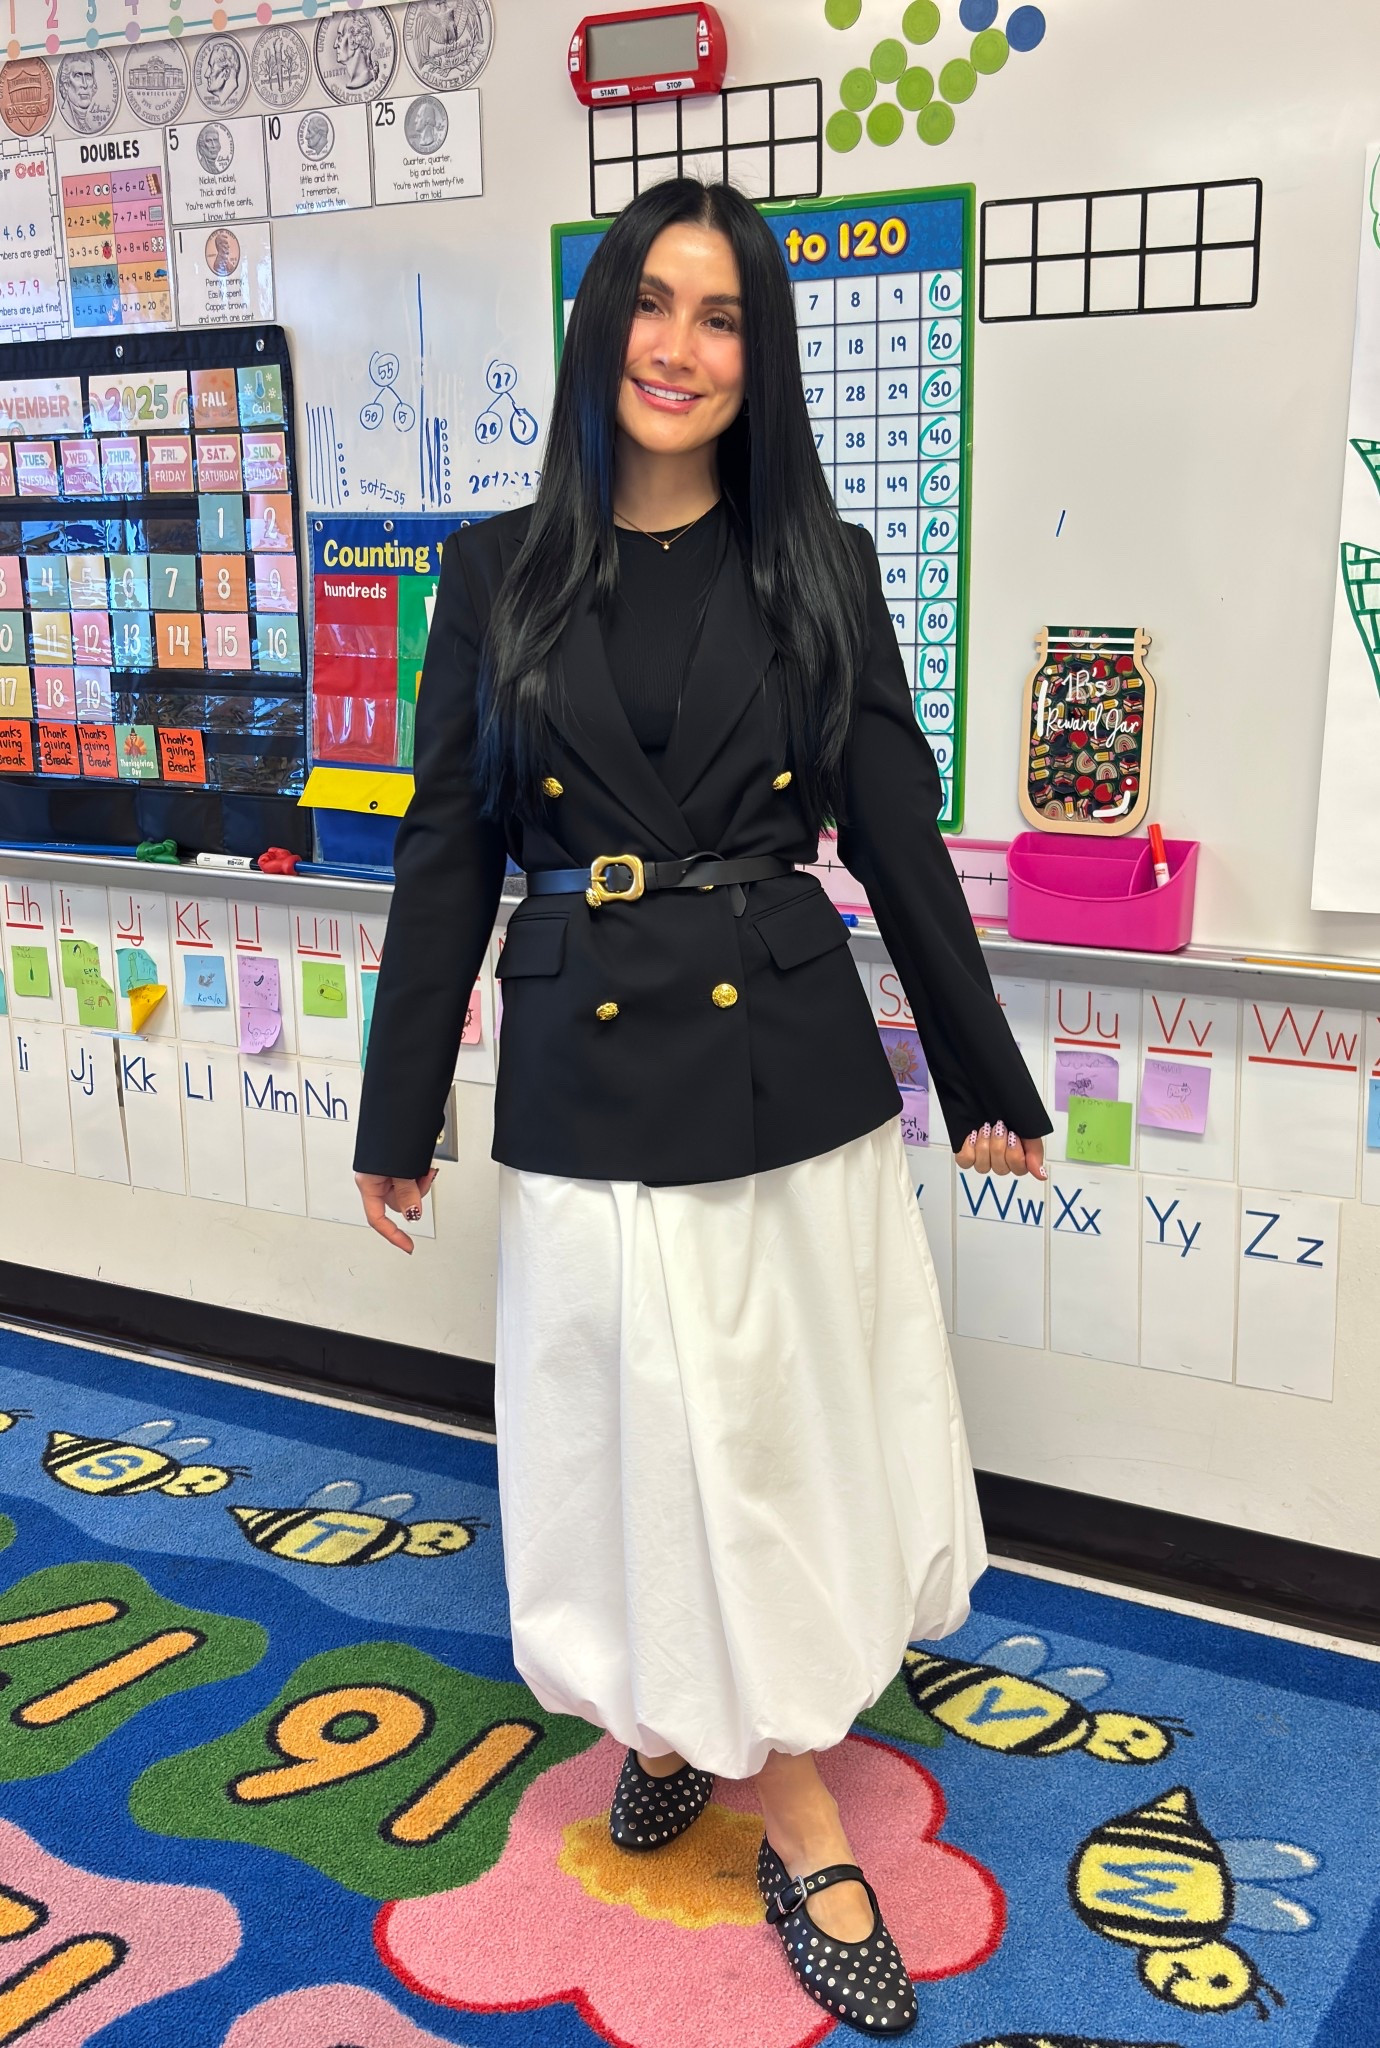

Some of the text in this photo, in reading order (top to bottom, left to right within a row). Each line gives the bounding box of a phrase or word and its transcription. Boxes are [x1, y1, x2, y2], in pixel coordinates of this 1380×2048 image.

[600, 88, 618, 97] START
[666, 81, 682, 90] STOP
[375, 102, 395, 127] 25
[268, 116, 281, 140] 10
[169, 128, 179, 151] 5
[80, 140, 140, 163] DOUBLES
[15, 161, 45, 179] Odd
[785, 216, 908, 265] to 120
[20, 250, 31, 258] are
[809, 294, 819, 310] 7
[850, 291, 861, 307] 8
[893, 288, 904, 304] 9
[934, 285, 951, 302] 10
[807, 341, 822, 358] 17
[848, 338, 864, 355] 18
[891, 336, 907, 352] 19
[931, 333, 952, 350] 20
[377, 362, 394, 380] 55
[804, 388, 824, 404] 27
[845, 385, 866, 402] 28
[888, 383, 908, 400] 29
[930, 381, 952, 398] 30
[104, 384, 169, 421] 2025
[202, 390, 228, 408] FALL
[252, 402, 271, 415] Cold
[364, 411, 378, 422] 50
[845, 432, 866, 449] 38
[887, 430, 908, 447] 39
[929, 428, 952, 445] 40
[23, 455, 48, 466] TUES.
[69, 452, 88, 464] WED.
[108, 450, 133, 463] THUR.
[161, 449, 178, 461] FRI.
[207, 448, 229, 460] SAT.
[253, 446, 274, 458] SUN.
[155, 470, 187, 482] FRIDAY
[200, 470, 239, 482] SATURDAY
[249, 467, 283, 480] SUNDAY
[844, 478, 866, 494] 48
[886, 476, 908, 493] 49
[928, 475, 951, 492] 50
[217, 507, 224, 539] 1
[263, 507, 278, 539] 2
[886, 522, 908, 538] 59
[928, 520, 950, 537] 60
[323, 538, 431, 574] Counting
[42, 567, 54, 596] 4
[82, 567, 94, 597] 5
[165, 567, 178, 598] 7
[218, 568, 231, 600] 8
[269, 568, 282, 600] 9
[886, 568, 906, 584] 69
[928, 568, 949, 584] 70
[324, 580, 387, 600] hundreds
[928, 613, 948, 629] 80
[45, 624, 58, 653] 11
[83, 624, 100, 654] 12
[124, 624, 142, 655] 13
[167, 625, 190, 656] 14
[216, 626, 238, 657] 15
[267, 627, 288, 659] 16
[927, 658, 947, 674] 90
[46, 678, 65, 708] 18
[86, 680, 101, 709] 19
[924, 703, 950, 718] 100
[1046, 701, 1139, 748] Reward Jar
[79, 727, 108, 740] Thanks
[160, 732, 194, 746] Thanks
[44, 741, 72, 754] giving
[84, 741, 110, 756] giving
[166, 746, 196, 760] giving
[45, 753, 73, 766] Break
[87, 754, 112, 768] Break
[120, 759, 154, 770] Thanksgiving
[168, 760, 197, 773] Break
[132, 768, 142, 777] Day
[5, 884, 42, 923] Hh
[117, 896, 143, 947] Jj
[176, 900, 212, 941] Kk
[198, 992, 223, 1005] Koala
[1058, 988, 1119, 1040] Uu
[1152, 995, 1213, 1048] Vv
[1252, 1003, 1358, 1061] Ww
[70, 1047, 94, 1096] Jj
[123, 1054, 157, 1093] Kk
[244, 1070, 298, 1114] Mm
[304, 1078, 349, 1121] Nn
[959, 1172, 1044, 1226] Ww
[1052, 1184, 1102, 1236] Xx
[1145, 1195, 1202, 1258] Yy
[1244, 1210, 1324, 1267] Zz
[78, 1454, 144, 1483] S
[294, 1519, 371, 1554] T
